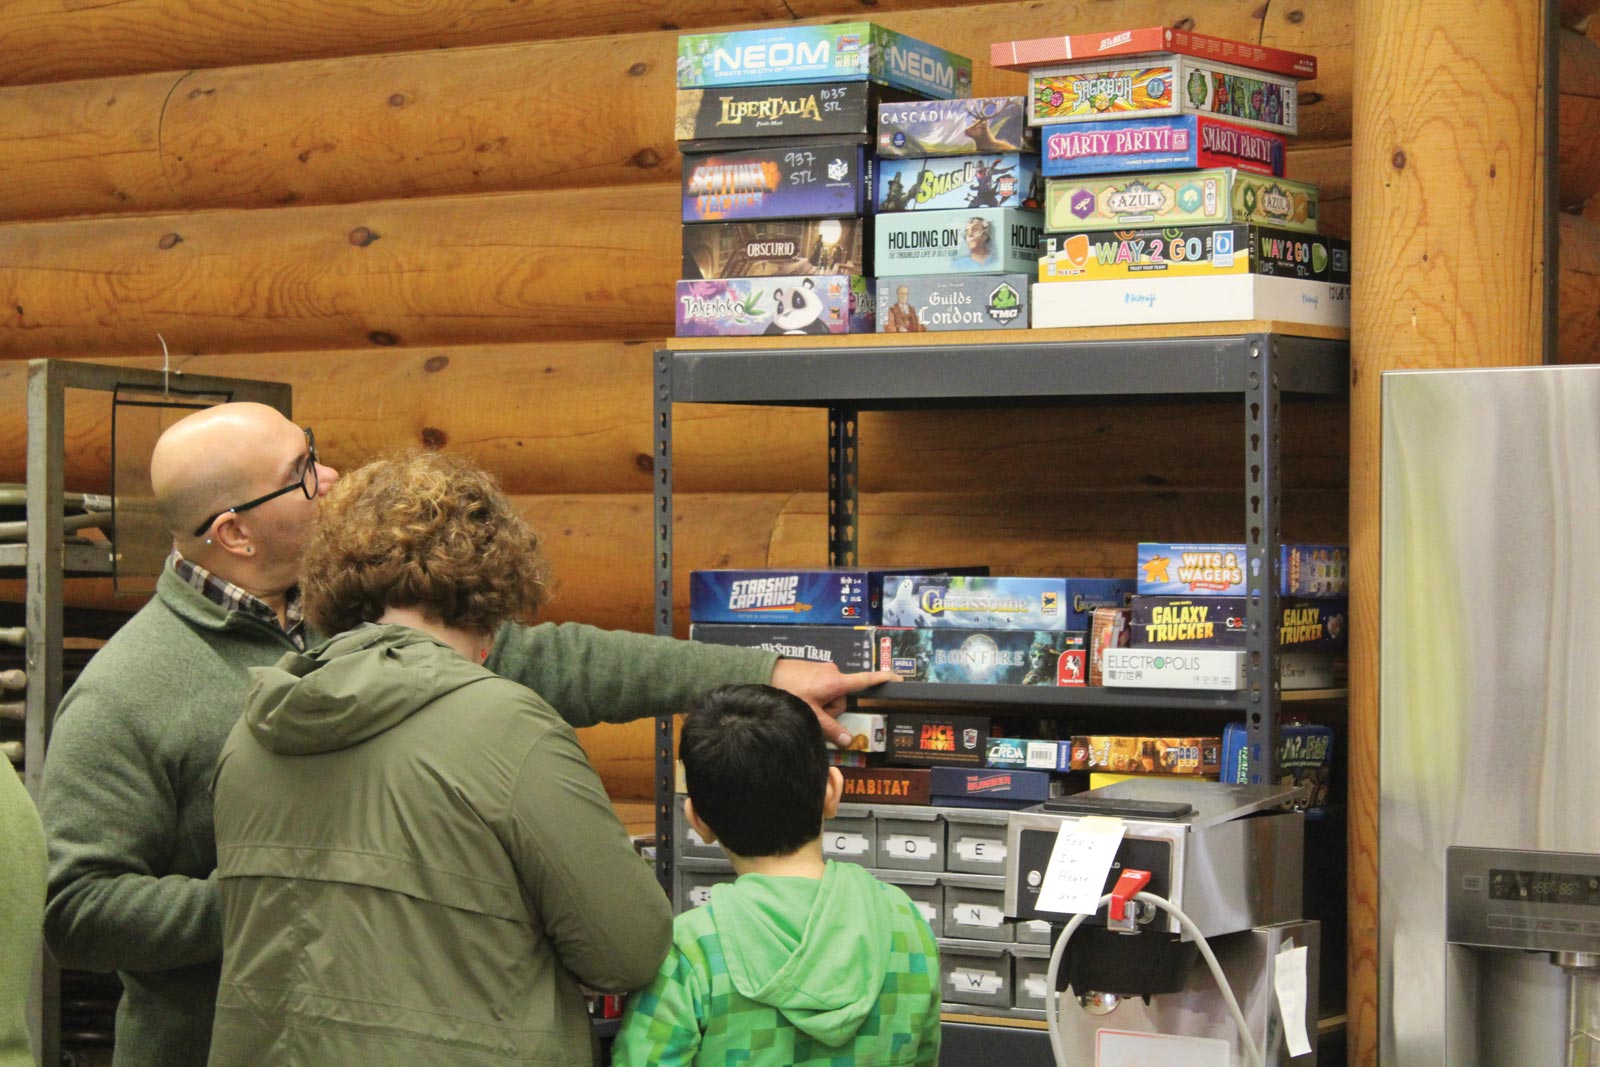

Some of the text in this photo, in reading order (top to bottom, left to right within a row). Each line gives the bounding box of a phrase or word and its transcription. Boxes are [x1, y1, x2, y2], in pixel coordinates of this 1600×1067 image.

[714, 40, 830, 72] NEOM
[891, 46, 954, 89] NEOM
[821, 87, 847, 100] 1035
[1073, 77, 1133, 110] SAGRADA
[715, 95, 822, 126] LIBERTALIA
[824, 102, 842, 112] STL
[881, 110, 952, 124] CASCADIA
[1050, 129, 1170, 157] SMARTY PARTY!
[1203, 127, 1271, 162] SMARTY PARTY!
[785, 152, 816, 167] 937
[688, 163, 775, 197] SENTINEL
[790, 170, 817, 185] STL
[916, 170, 964, 203] SMASH
[700, 193, 763, 213] TACTICS
[1118, 194, 1155, 207] AZUL
[888, 229, 958, 249] HOLDING ON
[747, 242, 794, 257] OBSCURIO
[1095, 240, 1145, 265] WAY
[1150, 239, 1163, 262] 2
[1169, 237, 1202, 262] GO
[1262, 237, 1309, 263] WAY 2 GO
[855, 293, 876, 314] TAKE
[929, 292, 972, 305] Guilds
[918, 306, 983, 325] London
[990, 309, 1018, 318] TMG
[1182, 553, 1236, 567] WITS &
[1179, 568, 1241, 583] WAGERS
[731, 576, 798, 595] STARSHIP
[729, 590, 796, 609] CAPTAINS
[922, 589, 1029, 613] Carcassonne
[1152, 606, 1208, 624] GALAXY
[1284, 608, 1319, 627] GALAXY
[1146, 622, 1213, 642] TRUCKER
[1280, 624, 1322, 645] TRUCKER
[935, 649, 1025, 666] BONFIRE
[1108, 655, 1200, 670] ELECTROPOLIS
[921, 725, 955, 740] DICE
[845, 779, 910, 795] HABITAT
[835, 836, 846, 850] C
[905, 840, 917, 853] D
[975, 843, 986, 856] E
[971, 909, 981, 921] N
[967, 974, 984, 988] W
